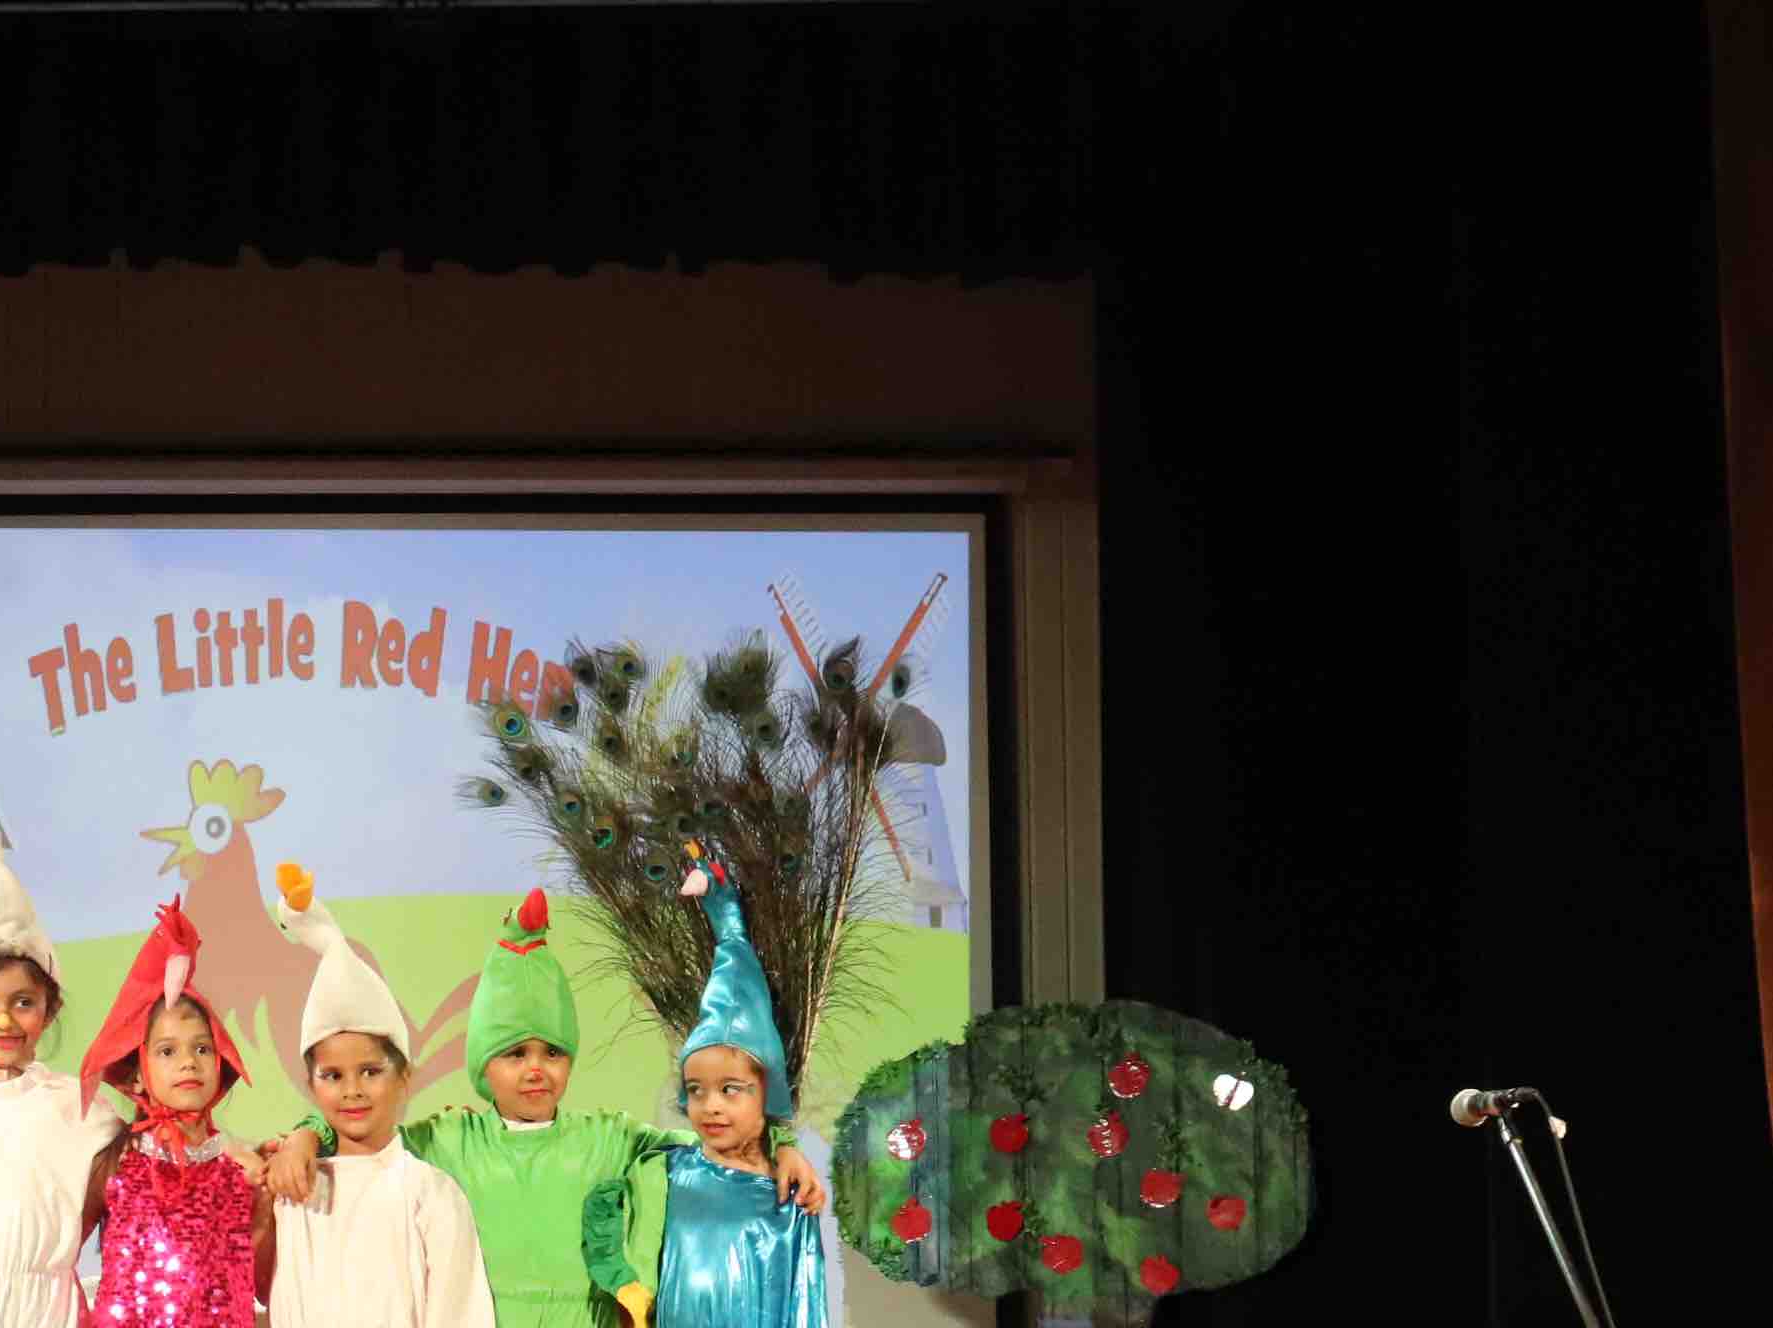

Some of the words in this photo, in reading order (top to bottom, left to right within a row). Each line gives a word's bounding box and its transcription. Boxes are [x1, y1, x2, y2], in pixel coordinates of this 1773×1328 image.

[28, 622, 136, 736] The
[154, 597, 316, 695] Little
[340, 599, 446, 697] Red
[466, 620, 575, 720] Hen
